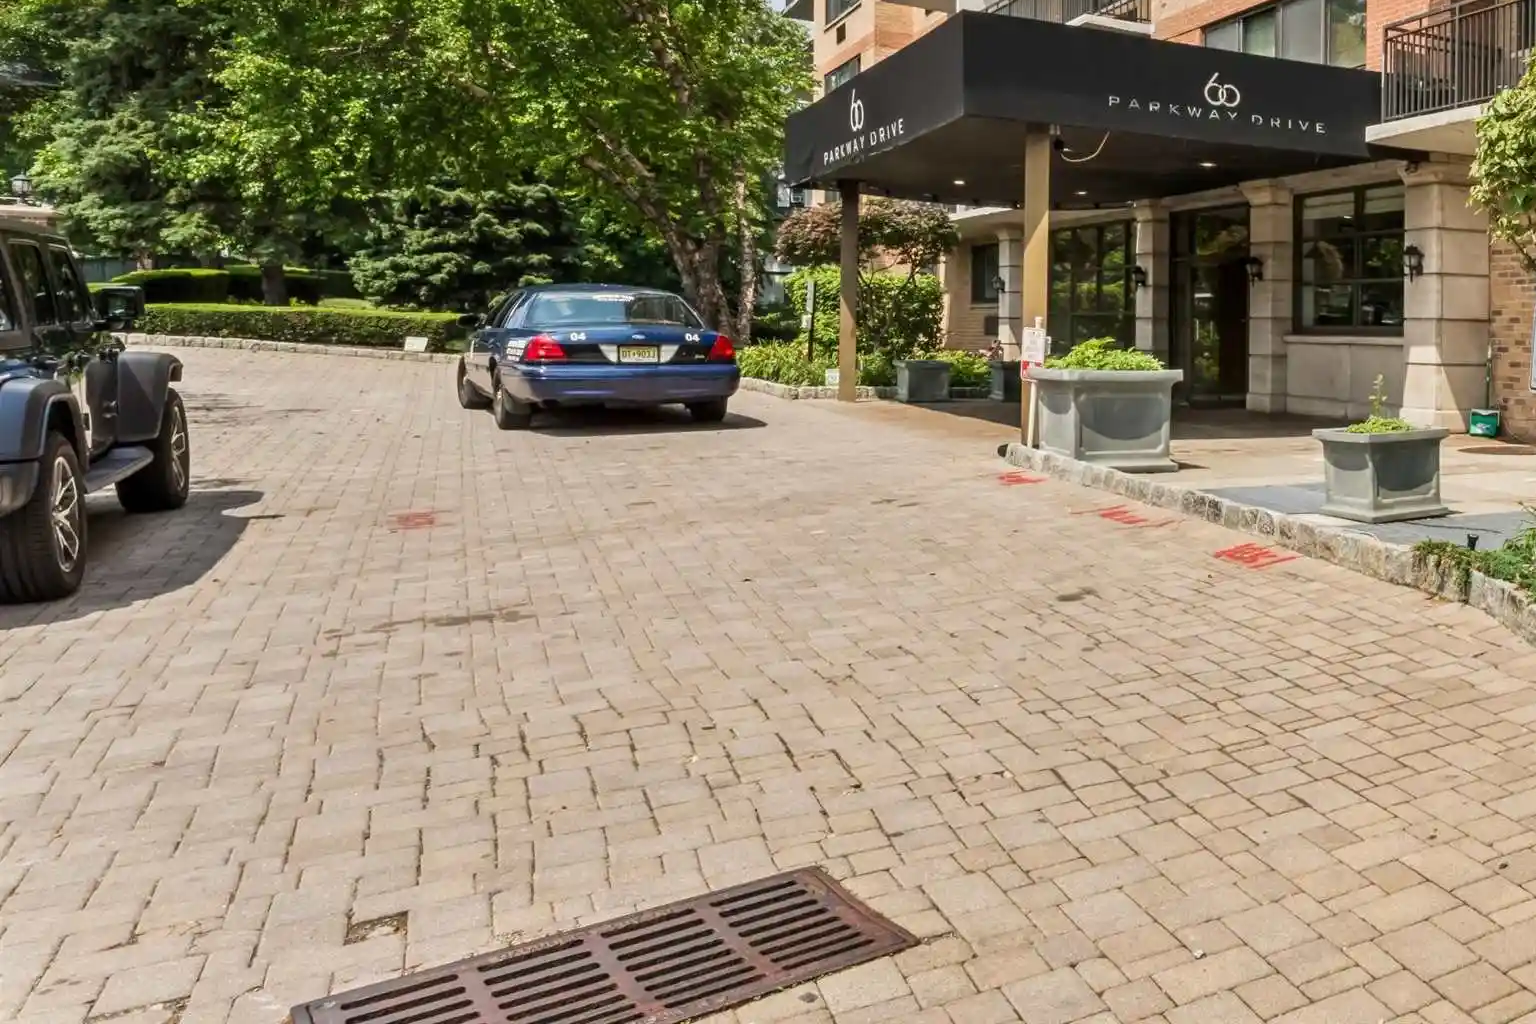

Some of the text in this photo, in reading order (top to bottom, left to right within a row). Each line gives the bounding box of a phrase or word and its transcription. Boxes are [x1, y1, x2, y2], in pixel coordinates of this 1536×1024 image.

[1204, 72, 1240, 107] 60
[1108, 95, 1326, 134] PARKWAY DRIVE
[823, 118, 904, 166] PARKWAY DRIVE
[684, 332, 700, 343] 04
